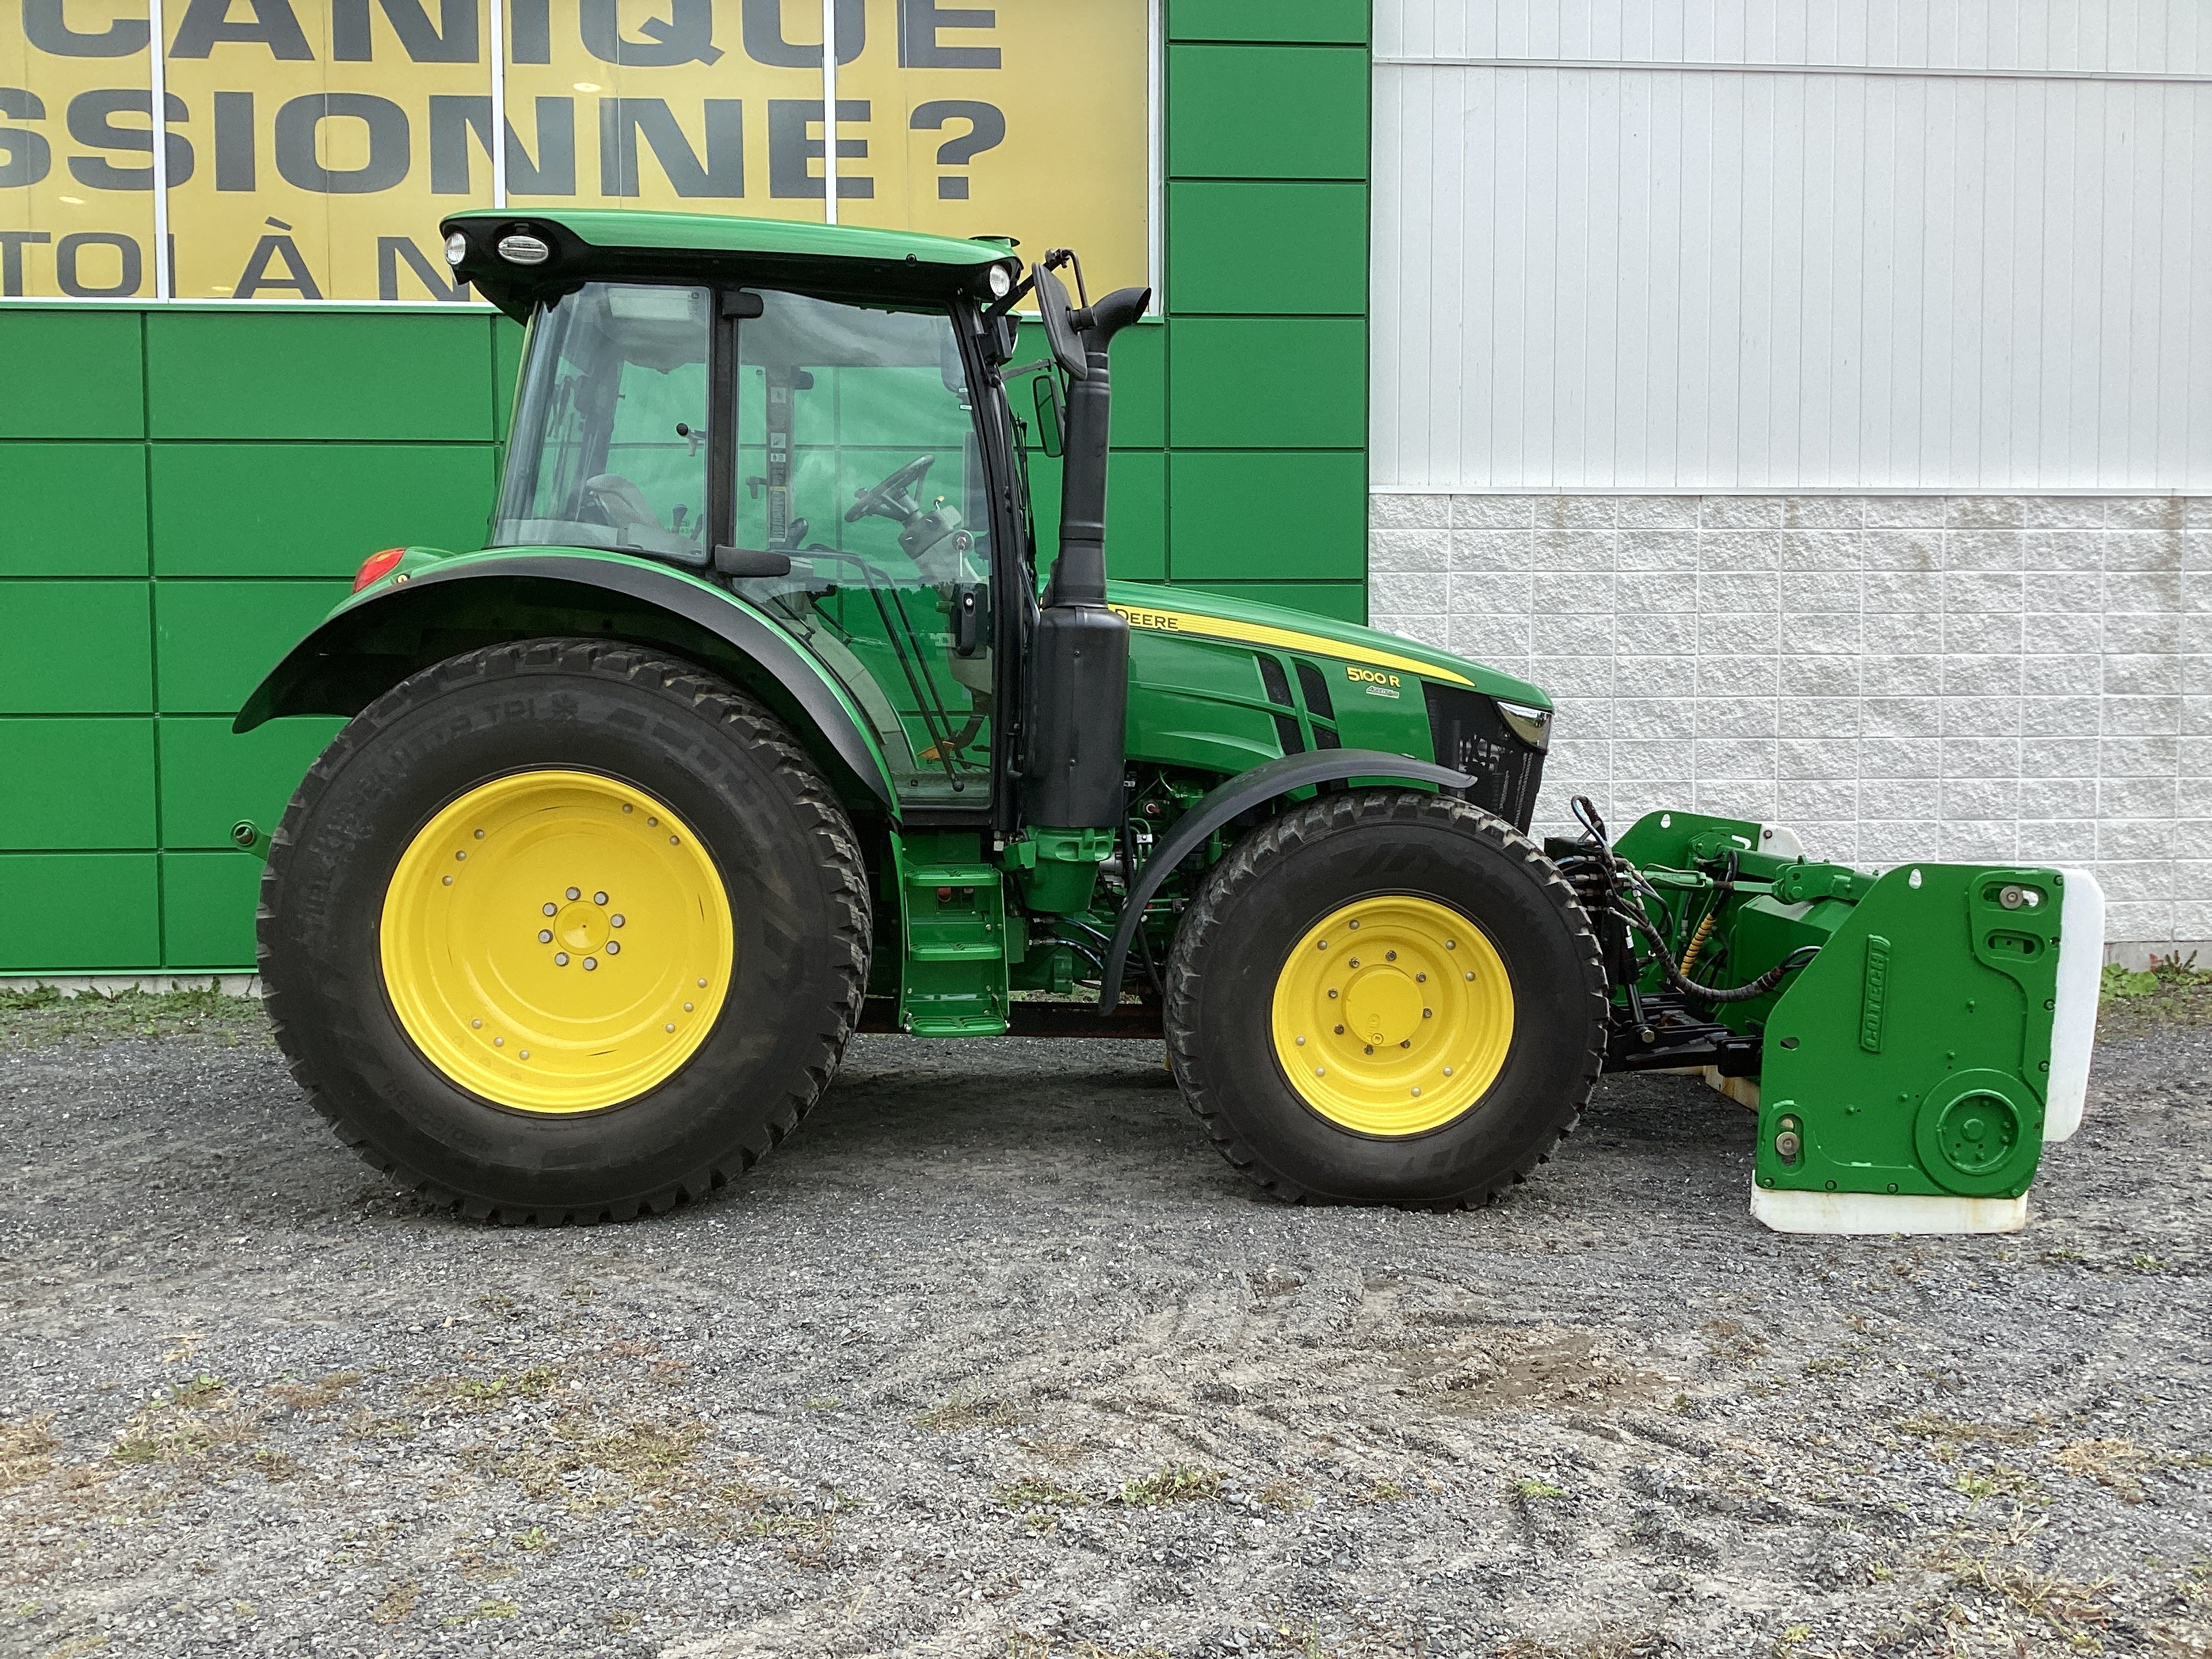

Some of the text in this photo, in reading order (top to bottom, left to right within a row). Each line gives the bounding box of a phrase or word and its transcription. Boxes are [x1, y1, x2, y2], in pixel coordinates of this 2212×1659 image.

[22, 0, 1002, 70] CANIQUE
[232, 216, 325, 300] À
[1346, 666, 1401, 689] 5100 R
